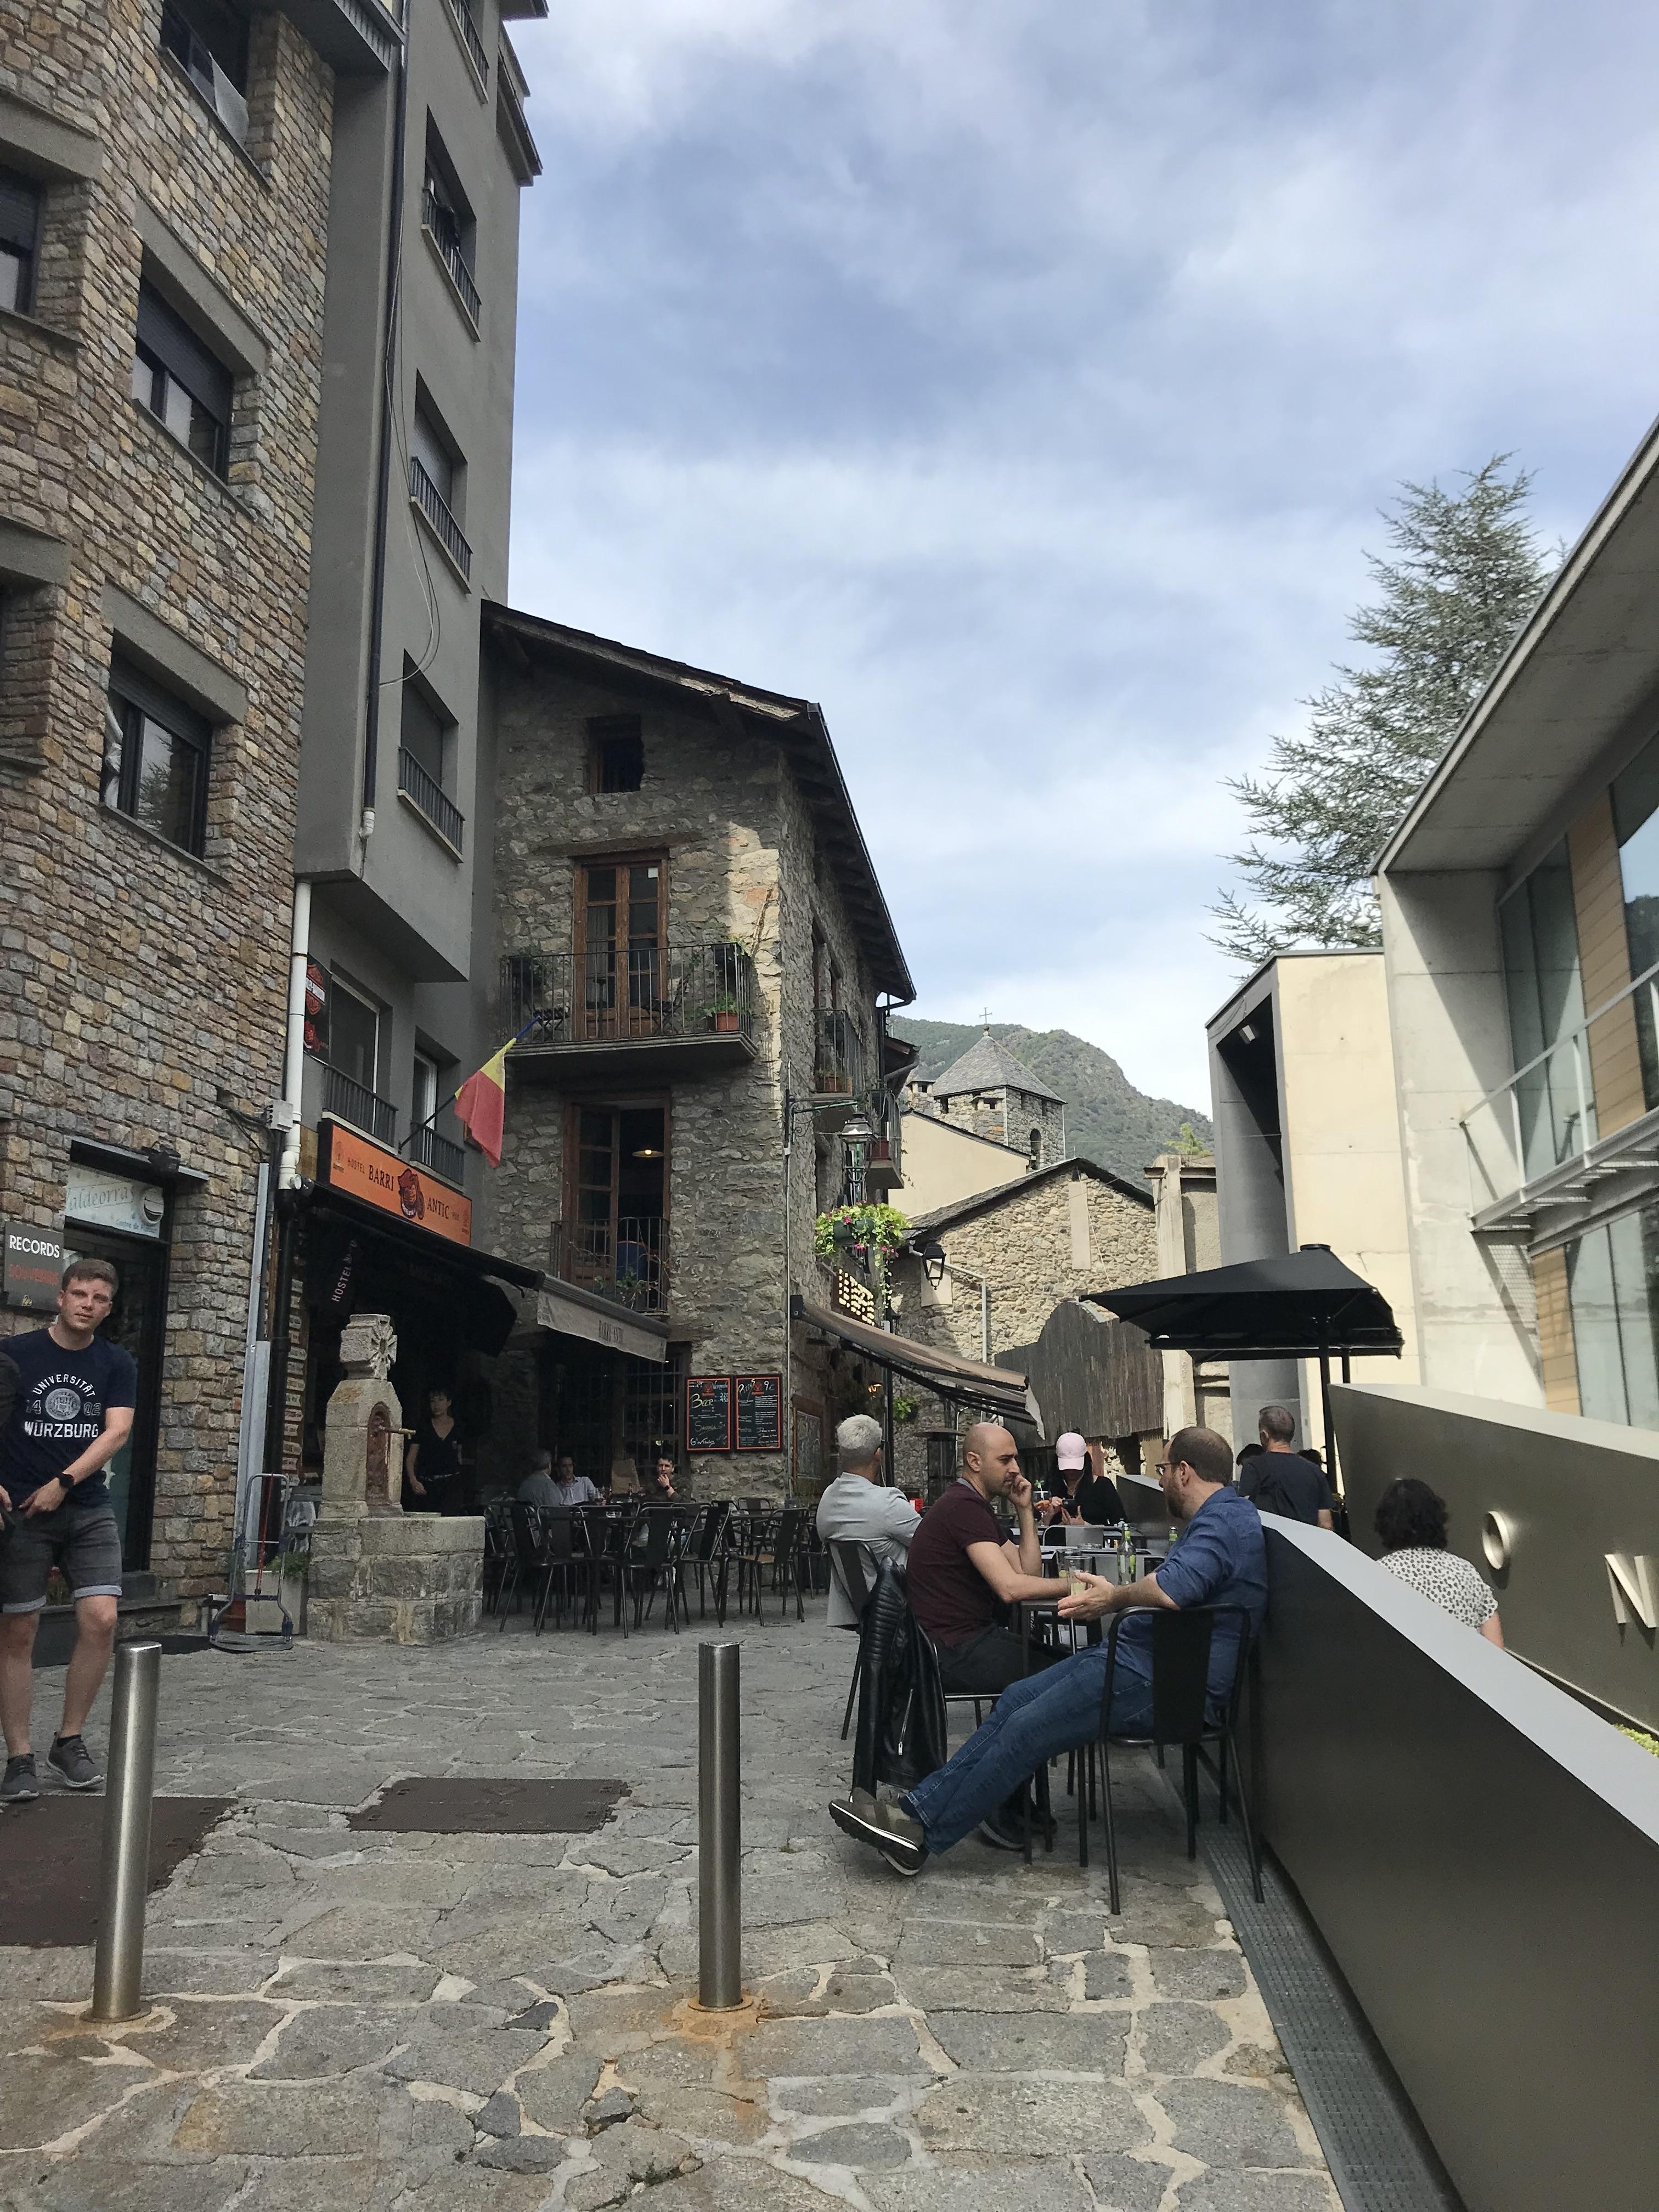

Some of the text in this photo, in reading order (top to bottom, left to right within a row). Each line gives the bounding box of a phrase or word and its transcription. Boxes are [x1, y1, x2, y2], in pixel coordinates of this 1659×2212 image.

[368, 1164, 394, 1192] BARRI
[427, 1197, 450, 1220] ANTIC
[9, 1234, 60, 1259] RECORDS
[331, 1266, 353, 1302] HOSTEL
[32, 1374, 96, 1397] UNIVERSITÄT
[83, 1402, 101, 1416] 02
[24, 1420, 99, 1438] WÜRZBURG
